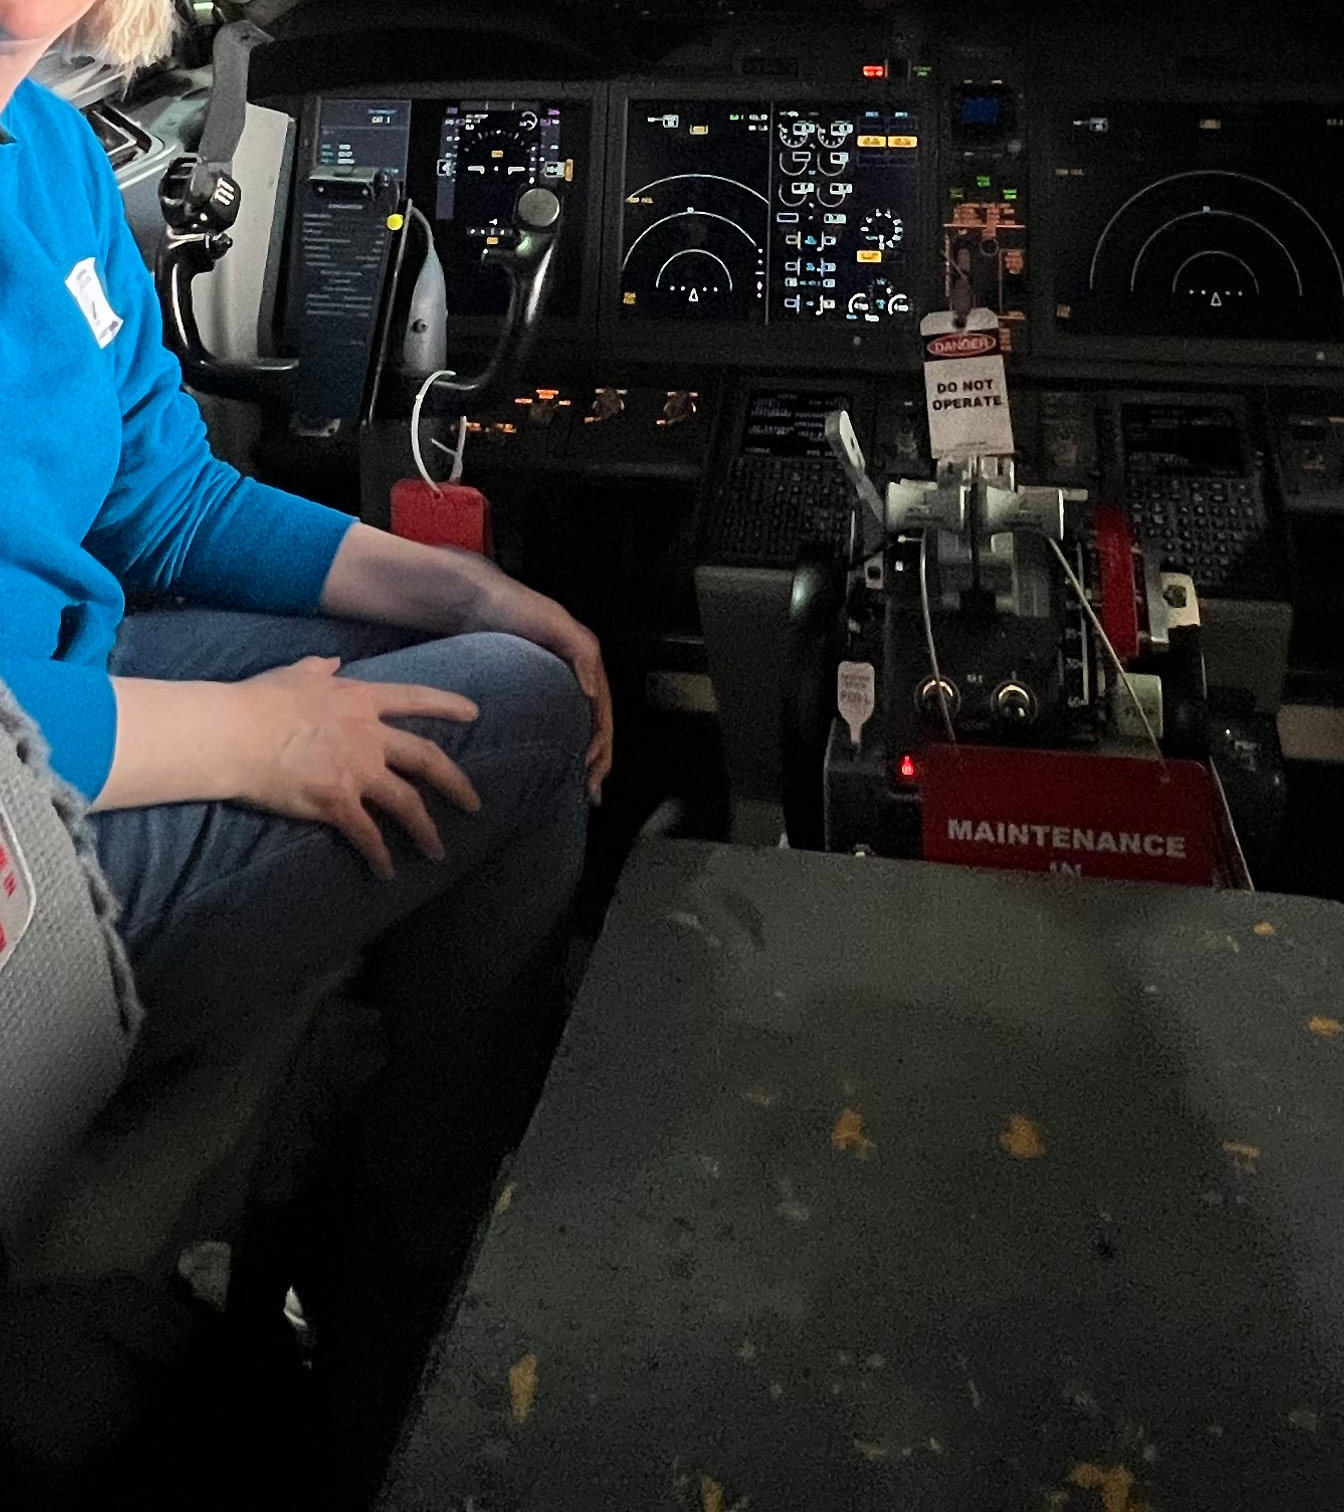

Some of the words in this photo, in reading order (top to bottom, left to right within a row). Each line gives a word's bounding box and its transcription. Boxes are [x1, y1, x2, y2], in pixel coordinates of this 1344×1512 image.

[935, 337, 990, 351] DANGER
[937, 381, 958, 394] DO
[962, 379, 993, 392] NOT
[932, 395, 1003, 411] OPERATE
[946, 817, 1187, 860] MAINTENANCE
